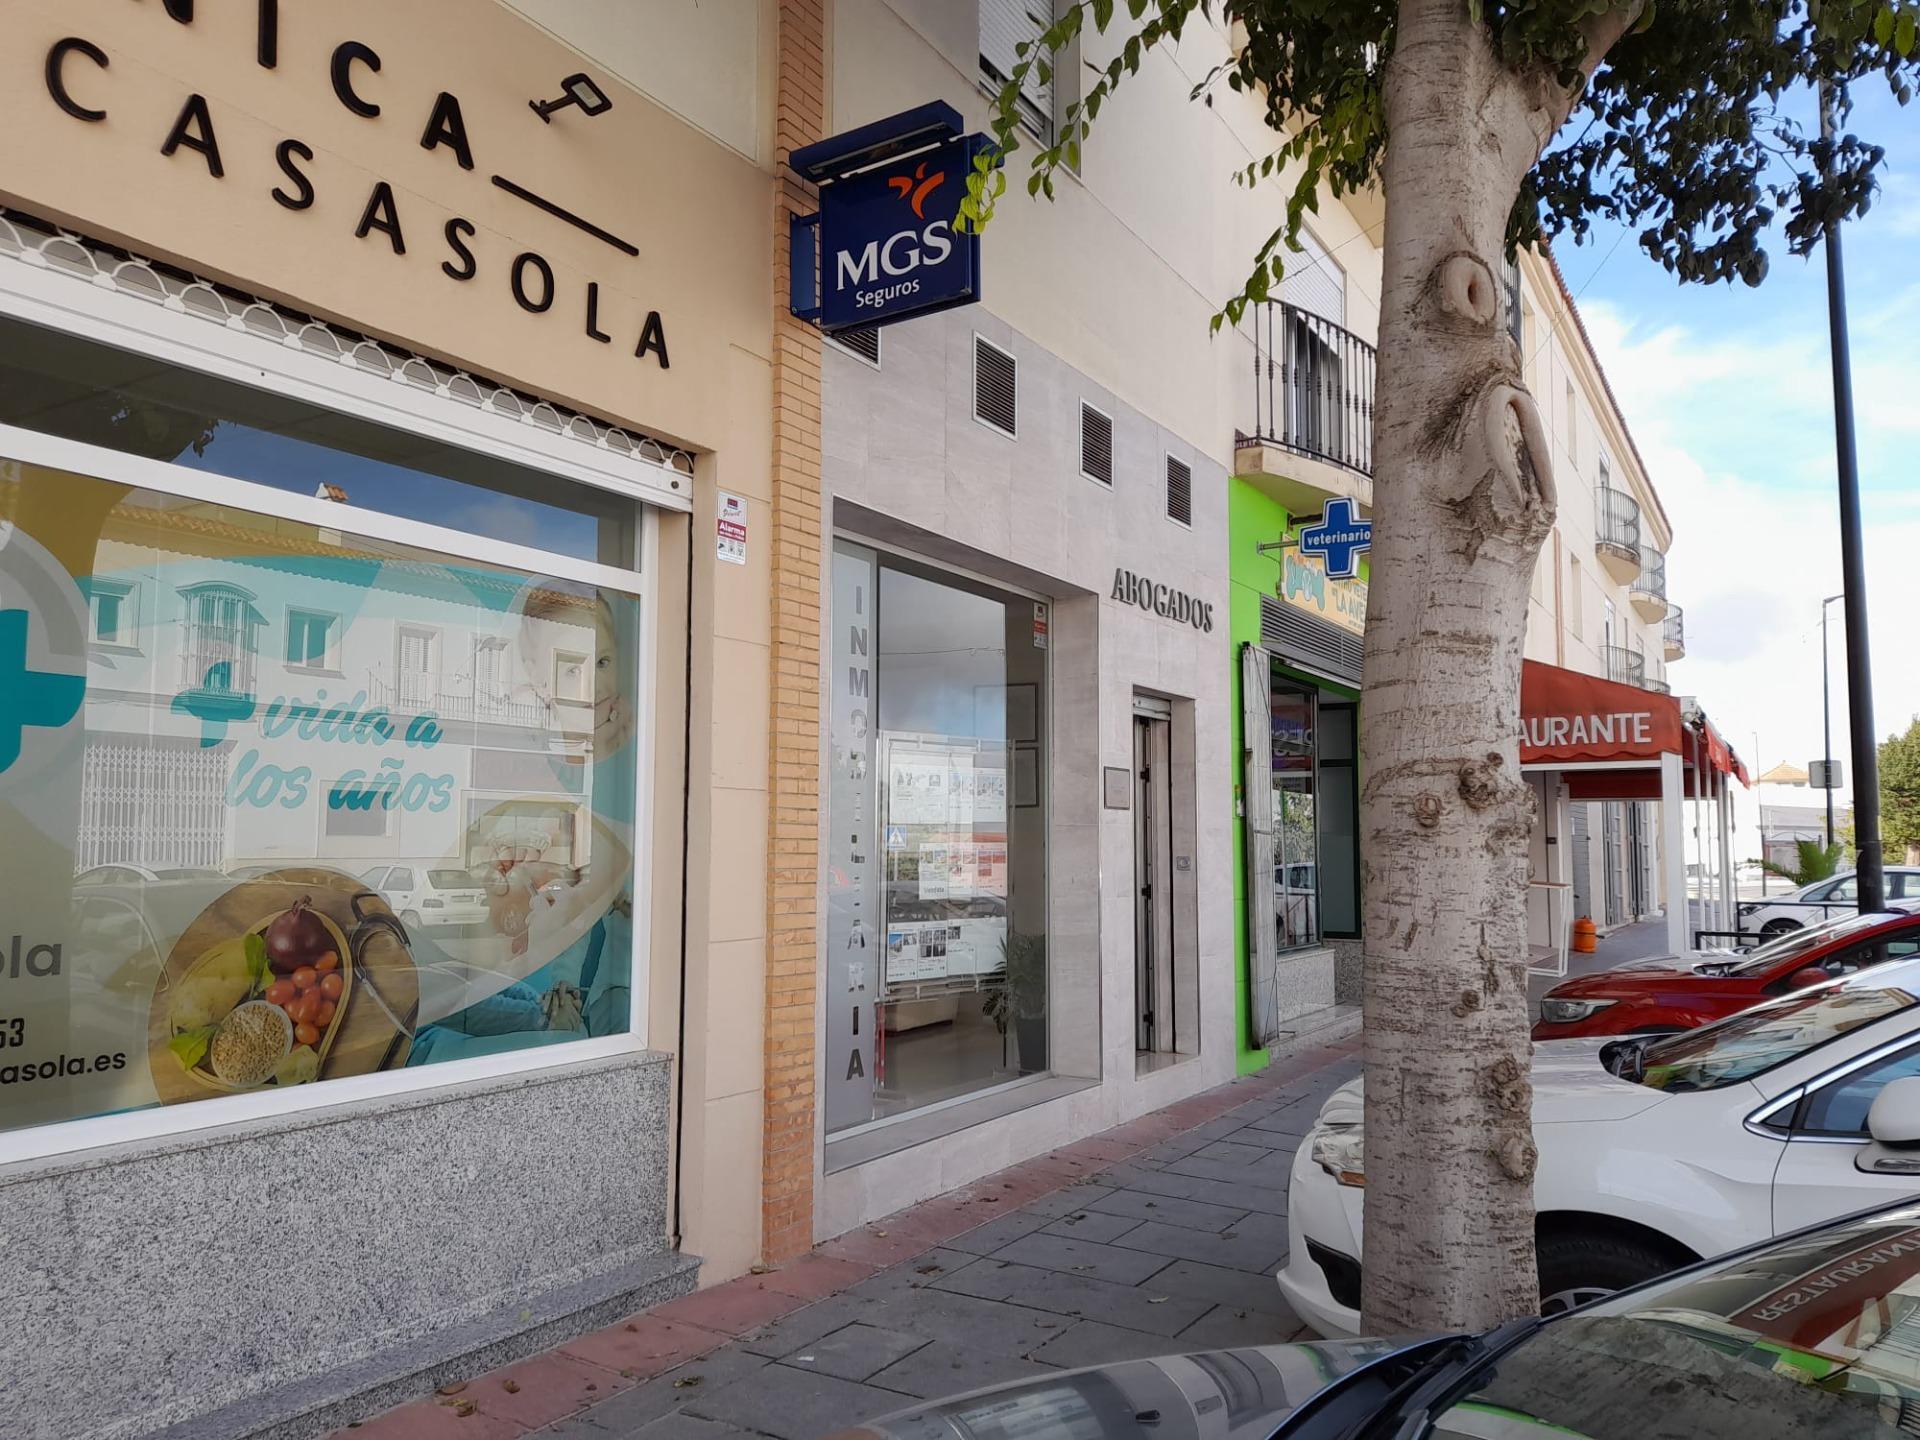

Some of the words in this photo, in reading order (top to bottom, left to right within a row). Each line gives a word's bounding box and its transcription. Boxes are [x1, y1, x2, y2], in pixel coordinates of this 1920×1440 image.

[162, 0, 474, 171] ICA
[45, 37, 670, 370] CASASOLA
[836, 220, 952, 291] MGS
[855, 279, 920, 308] Seguros
[1307, 530, 1371, 546] veterinario
[1110, 568, 1213, 633] ABOGADOS
[263, 689, 396, 746] vida
[405, 711, 443, 749] a
[1518, 711, 1652, 747] AURANTE
[226, 749, 312, 809] los
[328, 757, 454, 812] años
[0, 935, 62, 978] la
[0, 1052, 127, 1084] asola.es
